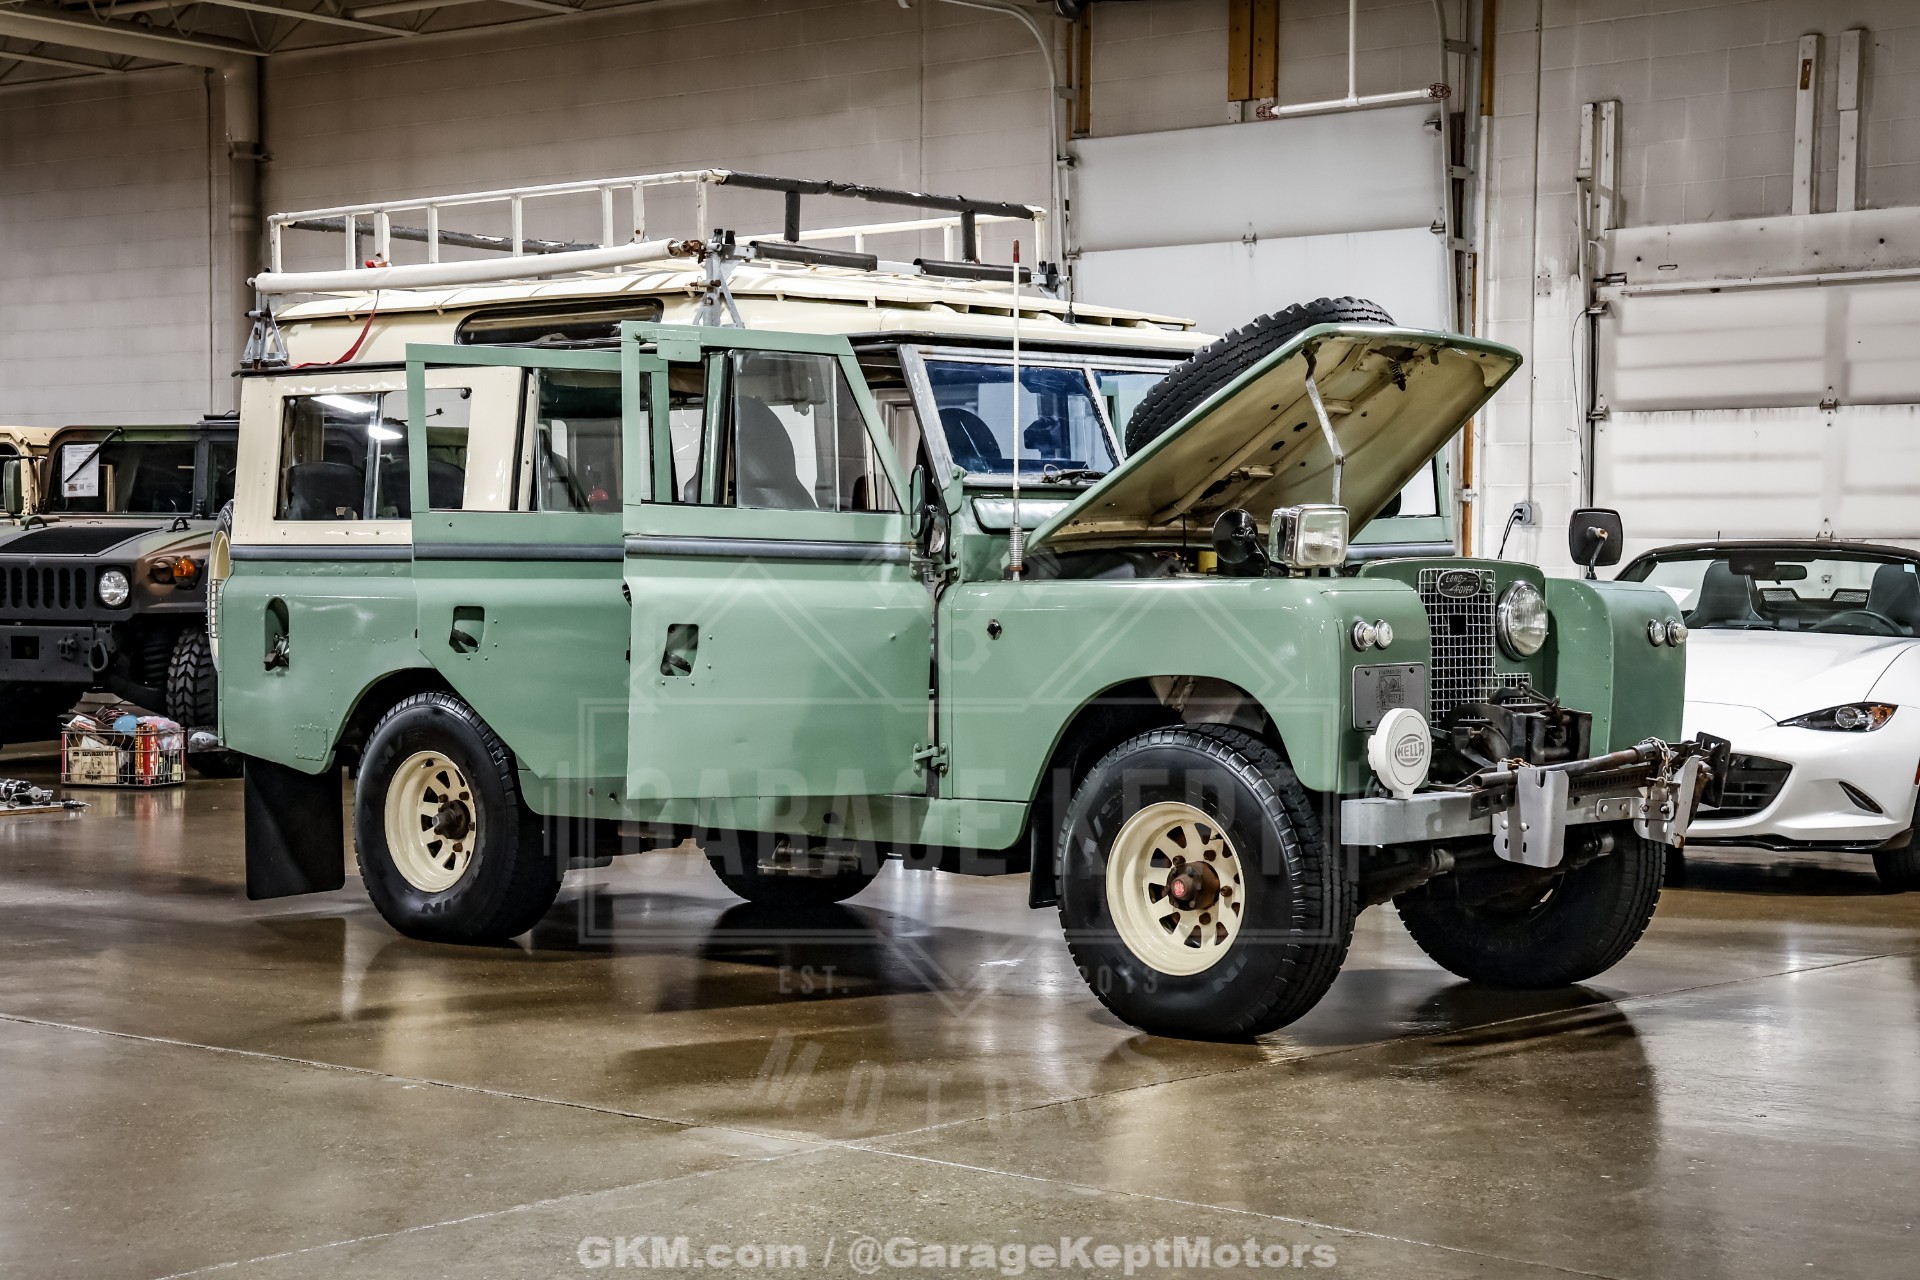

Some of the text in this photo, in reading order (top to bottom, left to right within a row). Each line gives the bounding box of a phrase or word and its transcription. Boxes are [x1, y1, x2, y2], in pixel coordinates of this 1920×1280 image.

[1445, 574, 1464, 583] LAND
[1453, 585, 1475, 594] ROVER
[1397, 741, 1425, 757] HELLA
